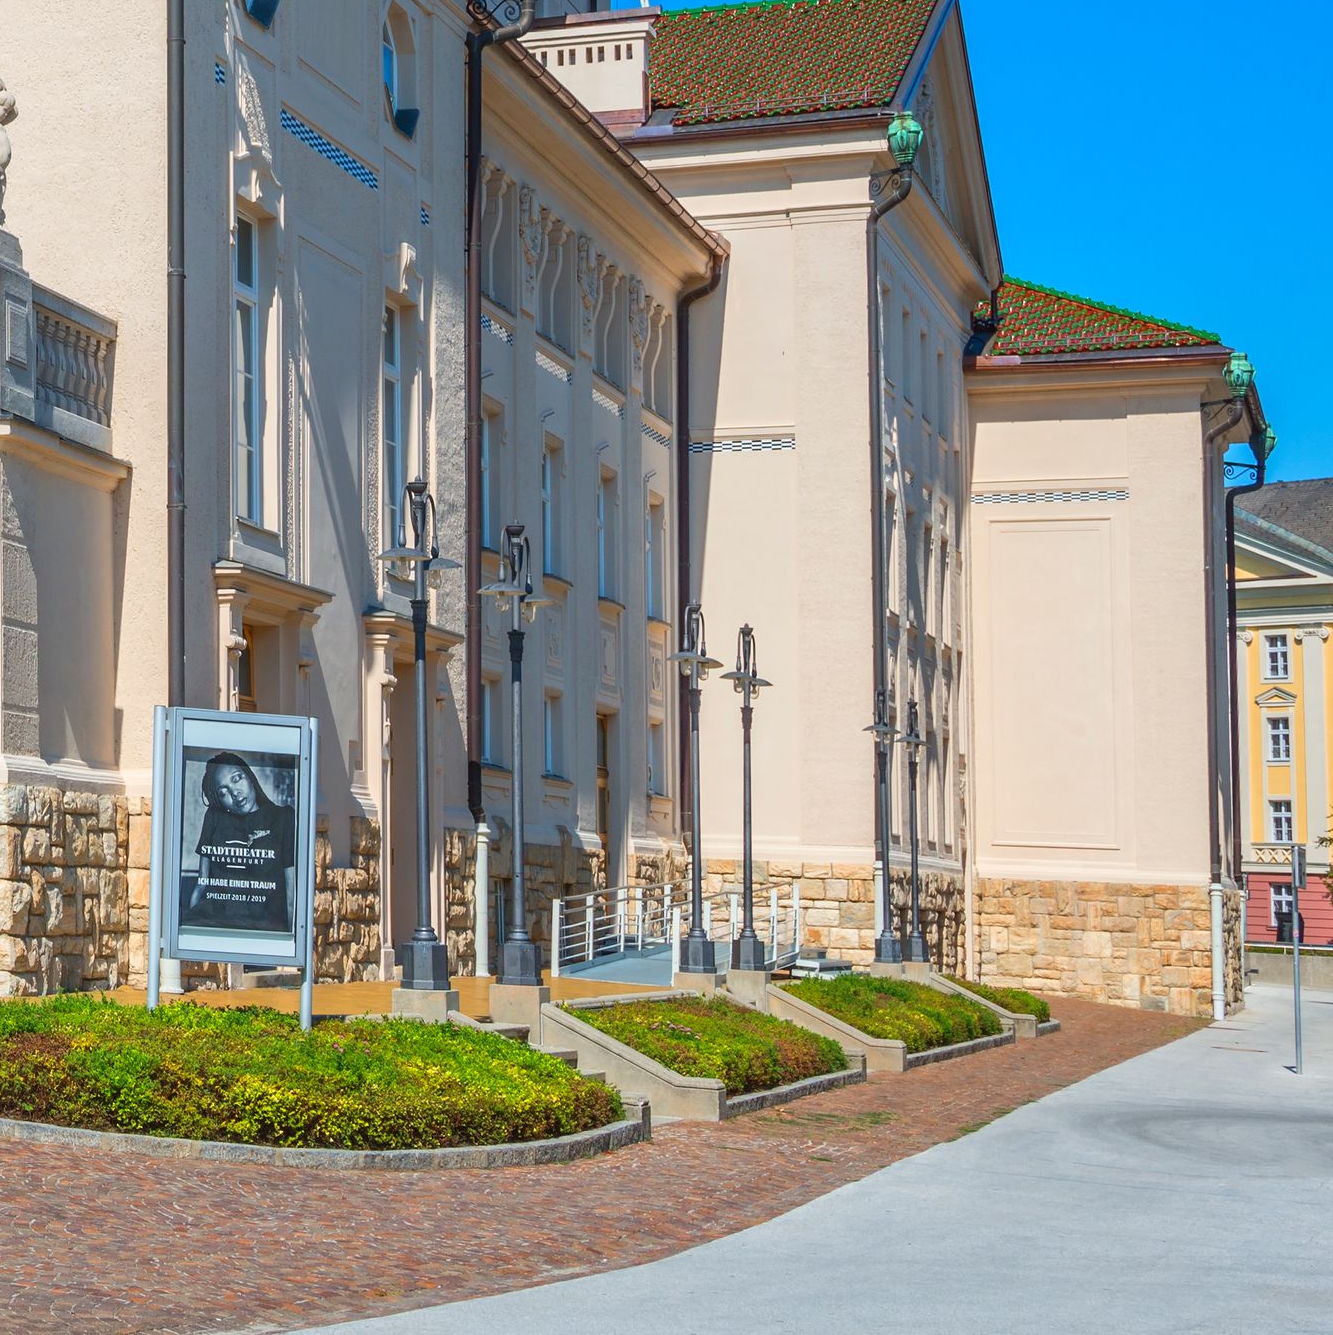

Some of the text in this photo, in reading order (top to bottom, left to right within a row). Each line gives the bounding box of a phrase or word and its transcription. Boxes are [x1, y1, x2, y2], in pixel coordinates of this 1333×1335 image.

[201, 845, 275, 859] STADTTHEATER
[211, 856, 264, 865] KLAGENFURT
[197, 877, 276, 890] ICH HABE EINEN TRAUM
[206, 892, 231, 900] SPIELZEIT
[231, 893, 246, 902] 2018
[251, 894, 267, 903] 2019
